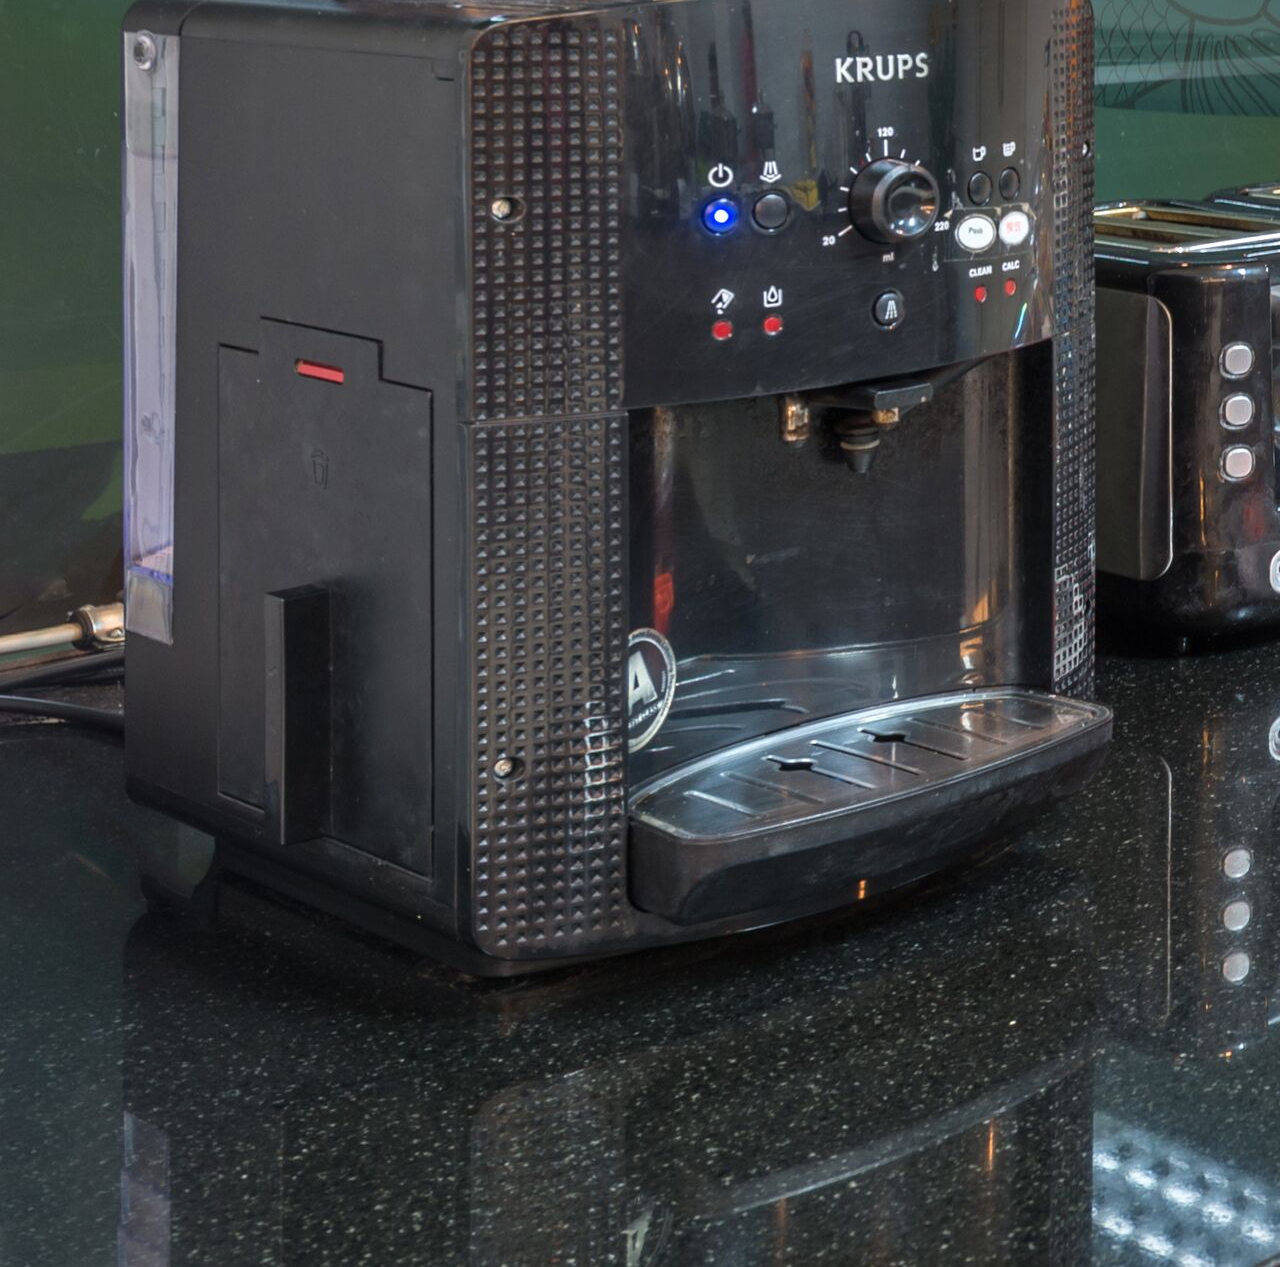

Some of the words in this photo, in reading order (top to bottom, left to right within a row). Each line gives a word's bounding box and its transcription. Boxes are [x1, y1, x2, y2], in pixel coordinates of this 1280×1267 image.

[835, 52, 929, 83] KRUPS
[877, 126, 894, 138] 120
[934, 220, 950, 232] 220
[822, 235, 836, 246] 20
[882, 252, 895, 262] ml
[968, 265, 993, 278] CLEAN
[1002, 260, 1020, 272] CALC
